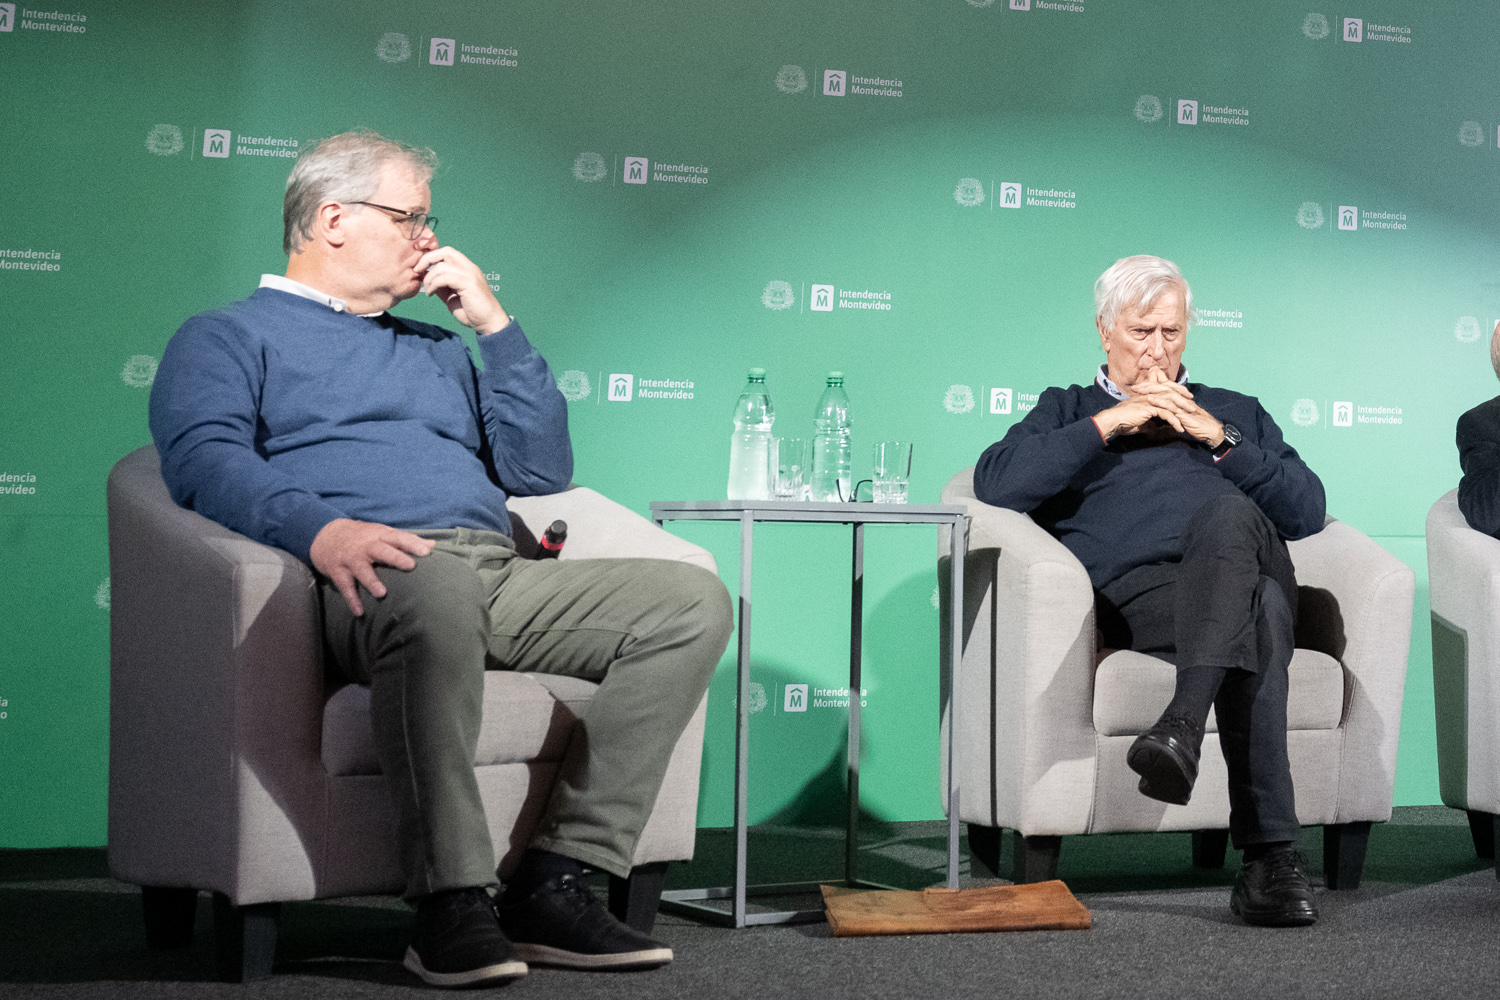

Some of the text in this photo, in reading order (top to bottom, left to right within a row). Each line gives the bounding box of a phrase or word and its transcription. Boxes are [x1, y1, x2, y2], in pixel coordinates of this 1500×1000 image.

[1036, 0, 1085, 12] Montevideo
[23, 8, 87, 22] Intendencia
[21, 20, 86, 34] Montevideo
[1367, 23, 1411, 34] Intendencia
[1367, 32, 1411, 43] Montevideo
[462, 44, 518, 56] Intendencia
[461, 54, 518, 67] Montevideo
[852, 75, 902, 87] Intendencia
[851, 85, 903, 97] Montevideo
[1203, 105, 1249, 116] Intendencia
[1203, 114, 1249, 126] Montevideo
[237, 134, 298, 147] Intendencia
[236, 146, 298, 158] Montevideo
[654, 162, 708, 174] Intendencia
[653, 172, 708, 184] Montevideo
[1027, 187, 1076, 198] Intendencia
[1027, 197, 1076, 208] Montevideo
[1363, 210, 1407, 220] Intendencia
[1362, 220, 1407, 230] Montevideo
[0, 249, 61, 260] ntendencia
[840, 289, 891, 300] Intendencia
[839, 300, 891, 311] Montevideo
[639, 378, 694, 389] Intendencia
[639, 389, 694, 399] Montevideo
[1358, 406, 1402, 414] Intendencia
[1358, 415, 1403, 424] Montevideo
[814, 687, 867, 697] Intendea
[813, 698, 867, 708] Montevio
